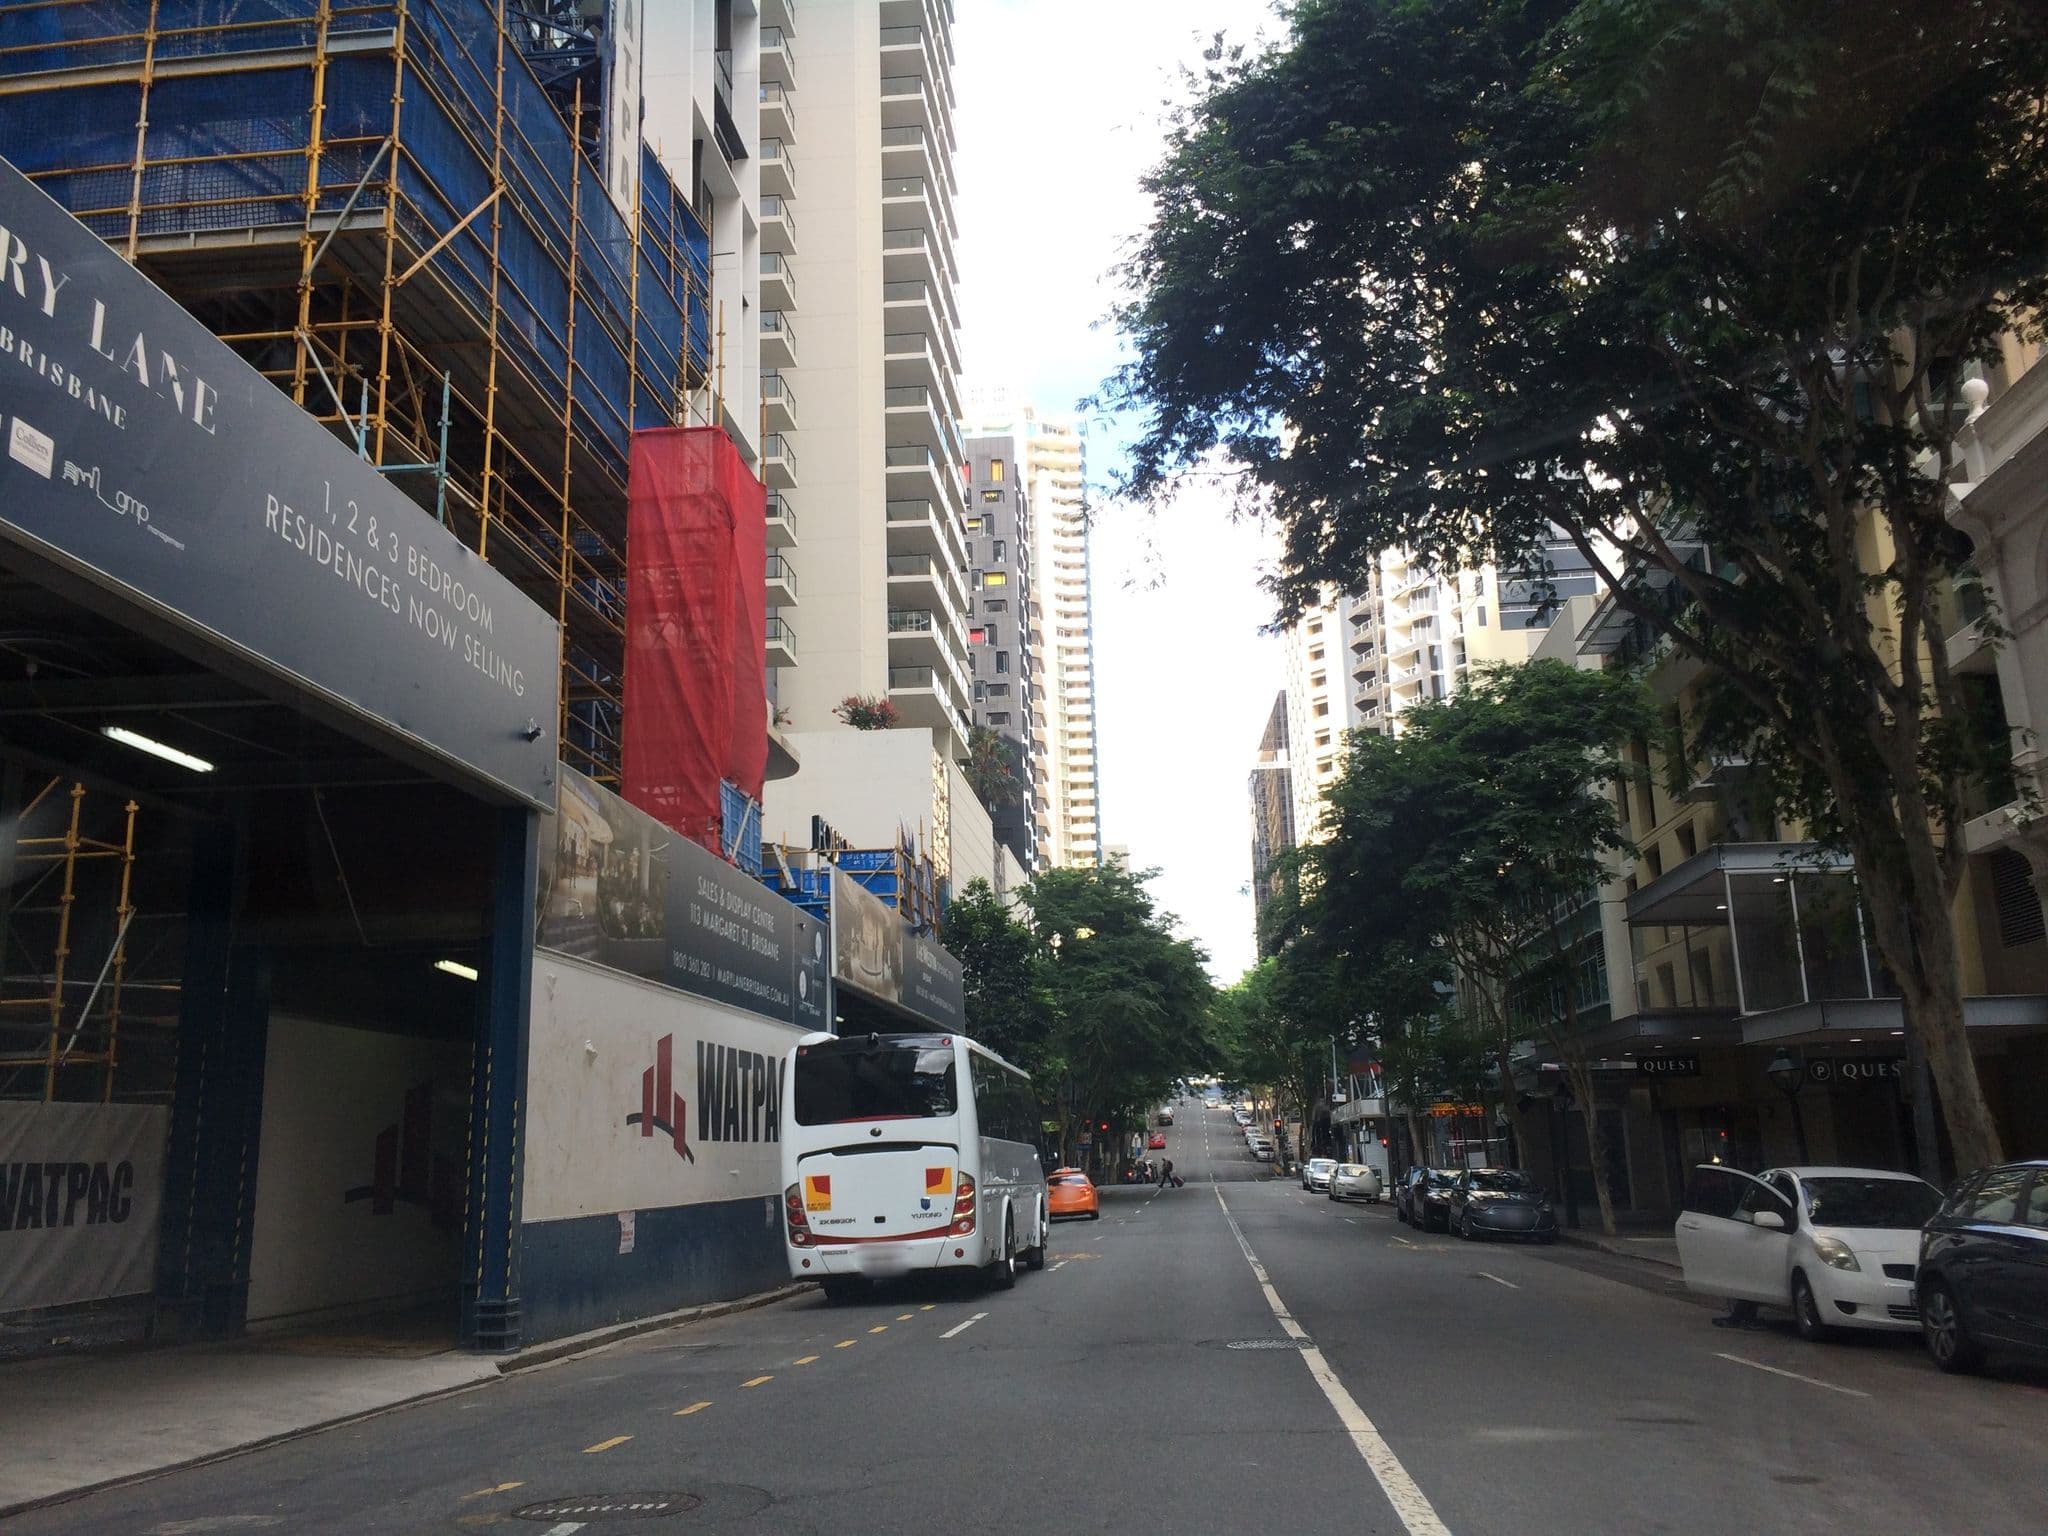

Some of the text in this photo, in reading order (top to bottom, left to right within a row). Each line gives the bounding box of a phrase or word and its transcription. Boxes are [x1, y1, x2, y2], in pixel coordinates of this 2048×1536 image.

[0, 324, 127, 430] BRISBANE
[89, 298, 218, 435] LANE
[324, 480, 494, 634] 1, 2 & 3 BEDROOM
[266, 493, 524, 697] RESIDENCES NOW SELLING
[690, 902, 701, 926] 113
[703, 911, 740, 943] MARGARET
[752, 932, 779, 961] BRISBANE
[698, 876, 718, 904] SALES
[727, 891, 752, 920] DISPLAY
[752, 906, 775, 933] CENTRE
[1643, 1060, 1696, 1073] QUEST
[1842, 1063, 1902, 1081] QUES
[911, 1212, 942, 1220] YUTONG
